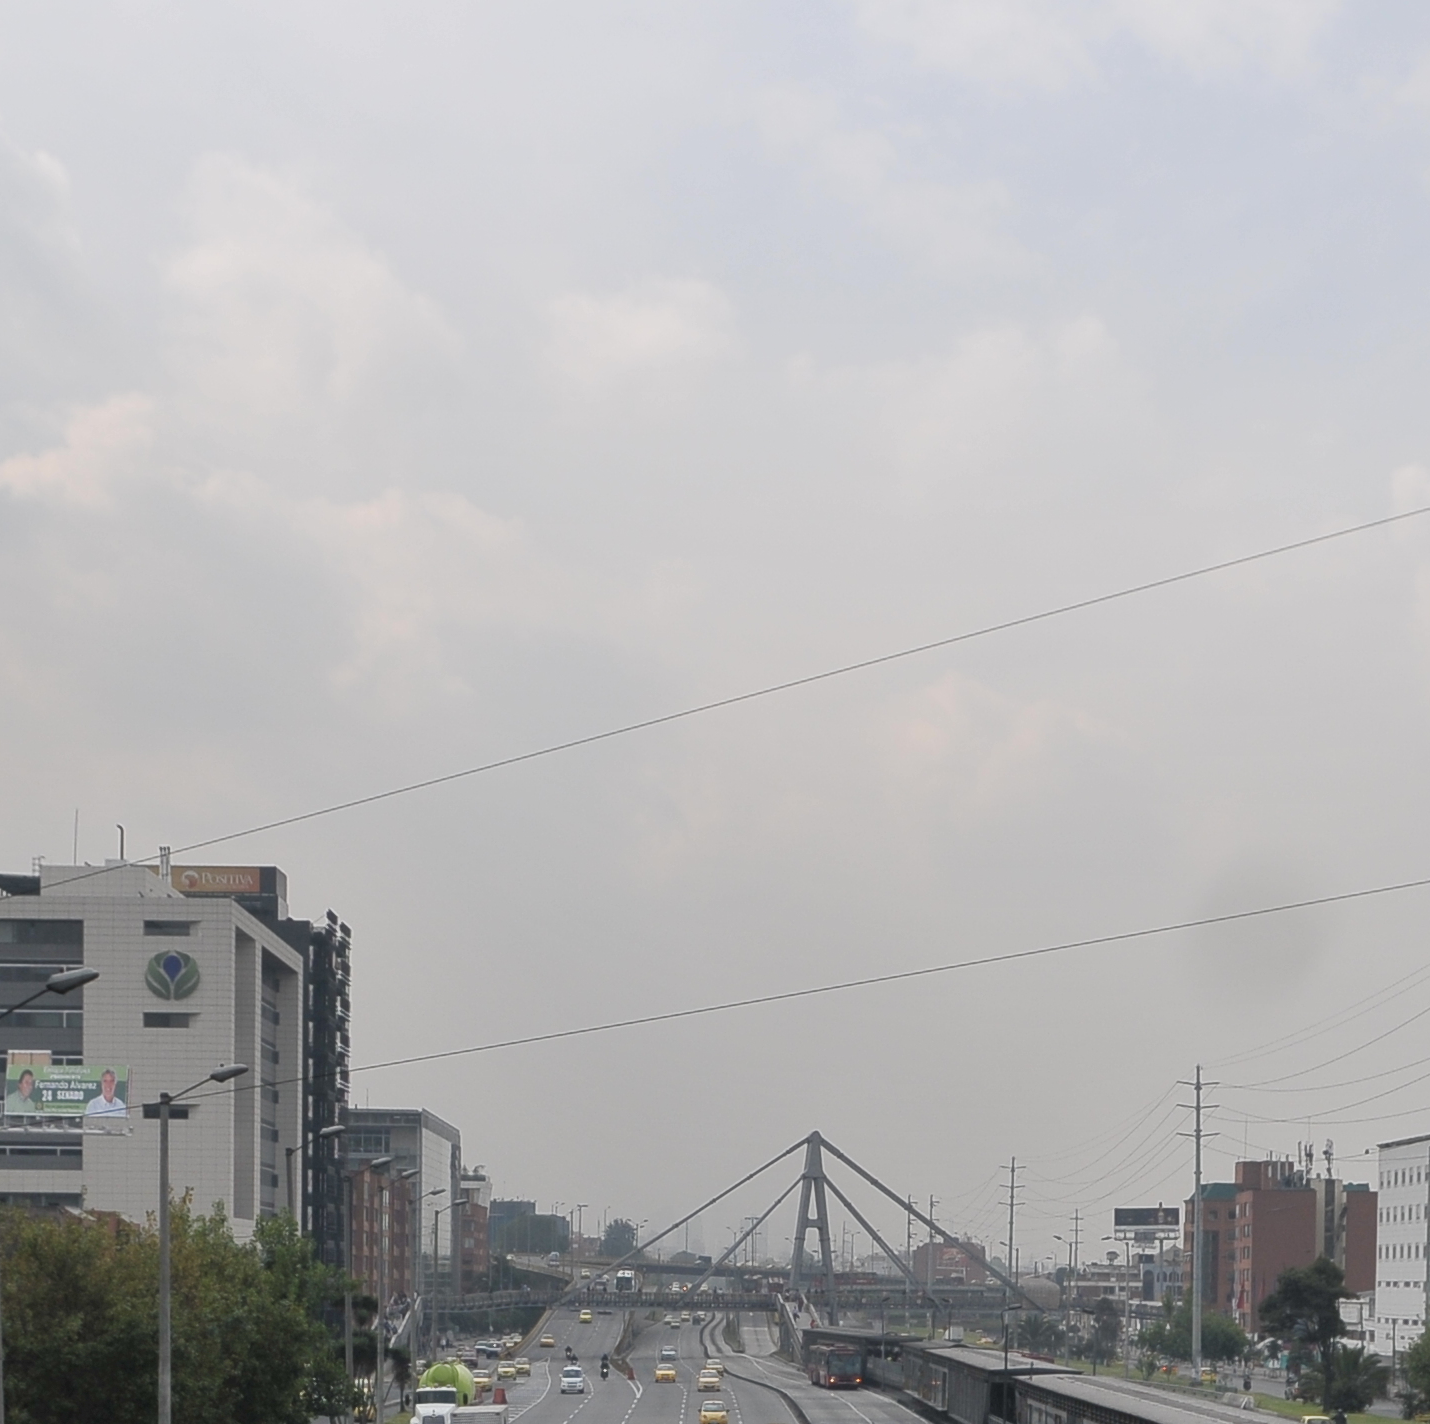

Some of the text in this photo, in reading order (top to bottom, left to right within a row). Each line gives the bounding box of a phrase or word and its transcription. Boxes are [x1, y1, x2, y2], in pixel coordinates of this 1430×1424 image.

[201, 872, 253, 885] POSITIVA
[34, 1080, 69, 1089] Fernando
[56, 1090, 84, 1100] SENADO
